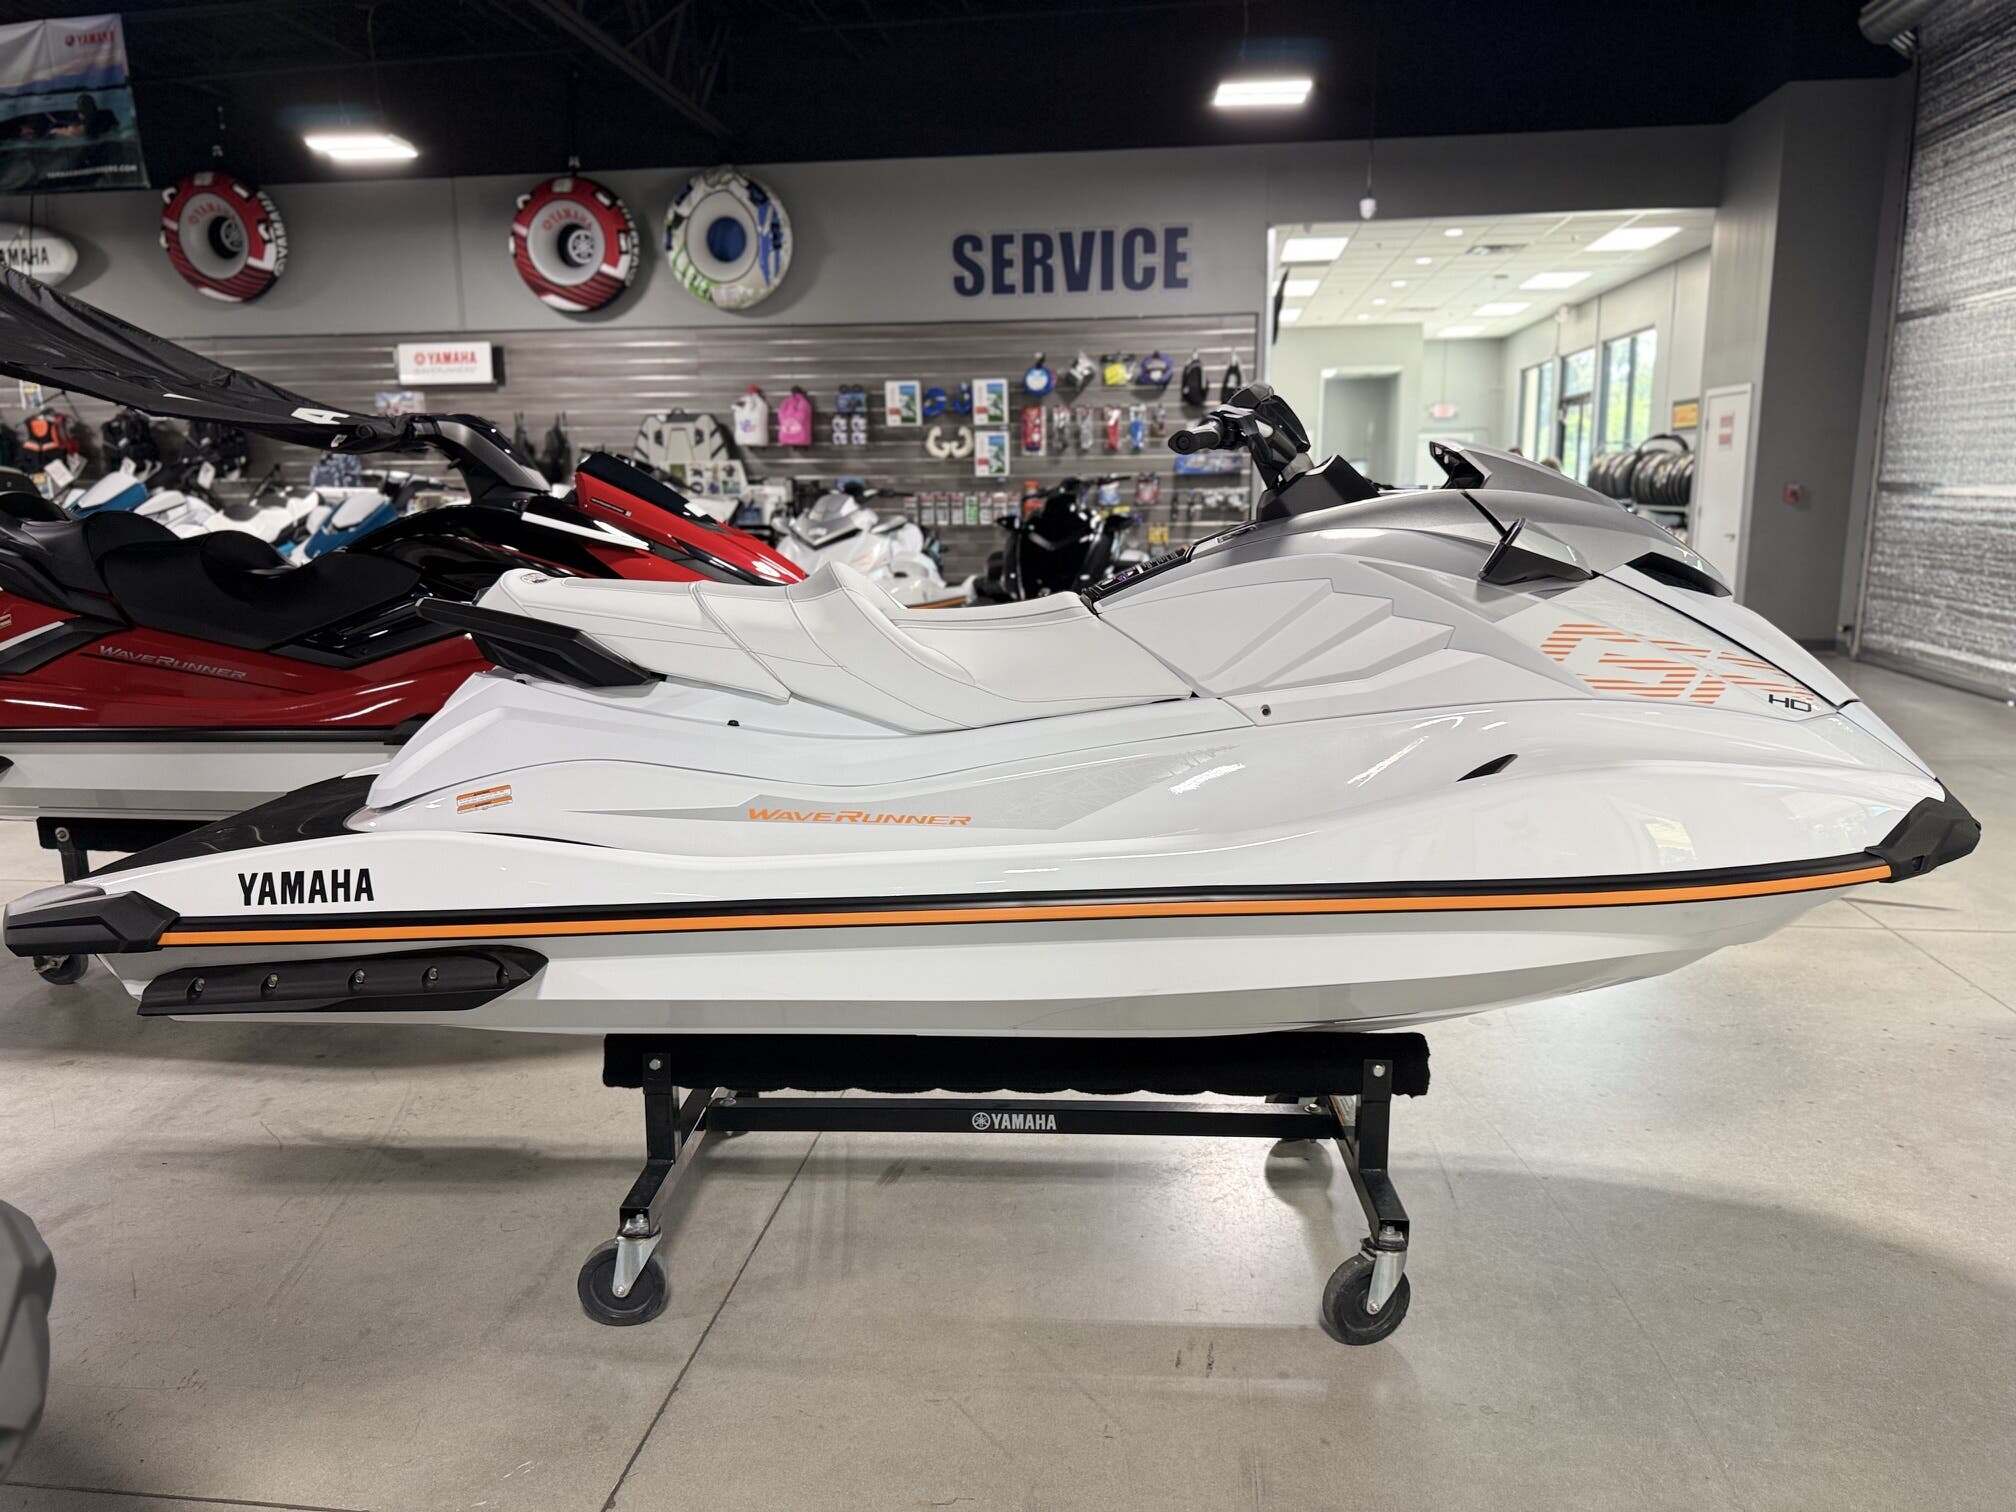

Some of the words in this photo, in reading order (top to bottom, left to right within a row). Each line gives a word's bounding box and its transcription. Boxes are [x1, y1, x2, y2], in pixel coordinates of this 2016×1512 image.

[952, 227, 1189, 297] SERVICE
[428, 351, 477, 365] YAMAHA
[238, 868, 375, 906] YAMAHA
[991, 1113, 1057, 1130] YAMAHA
